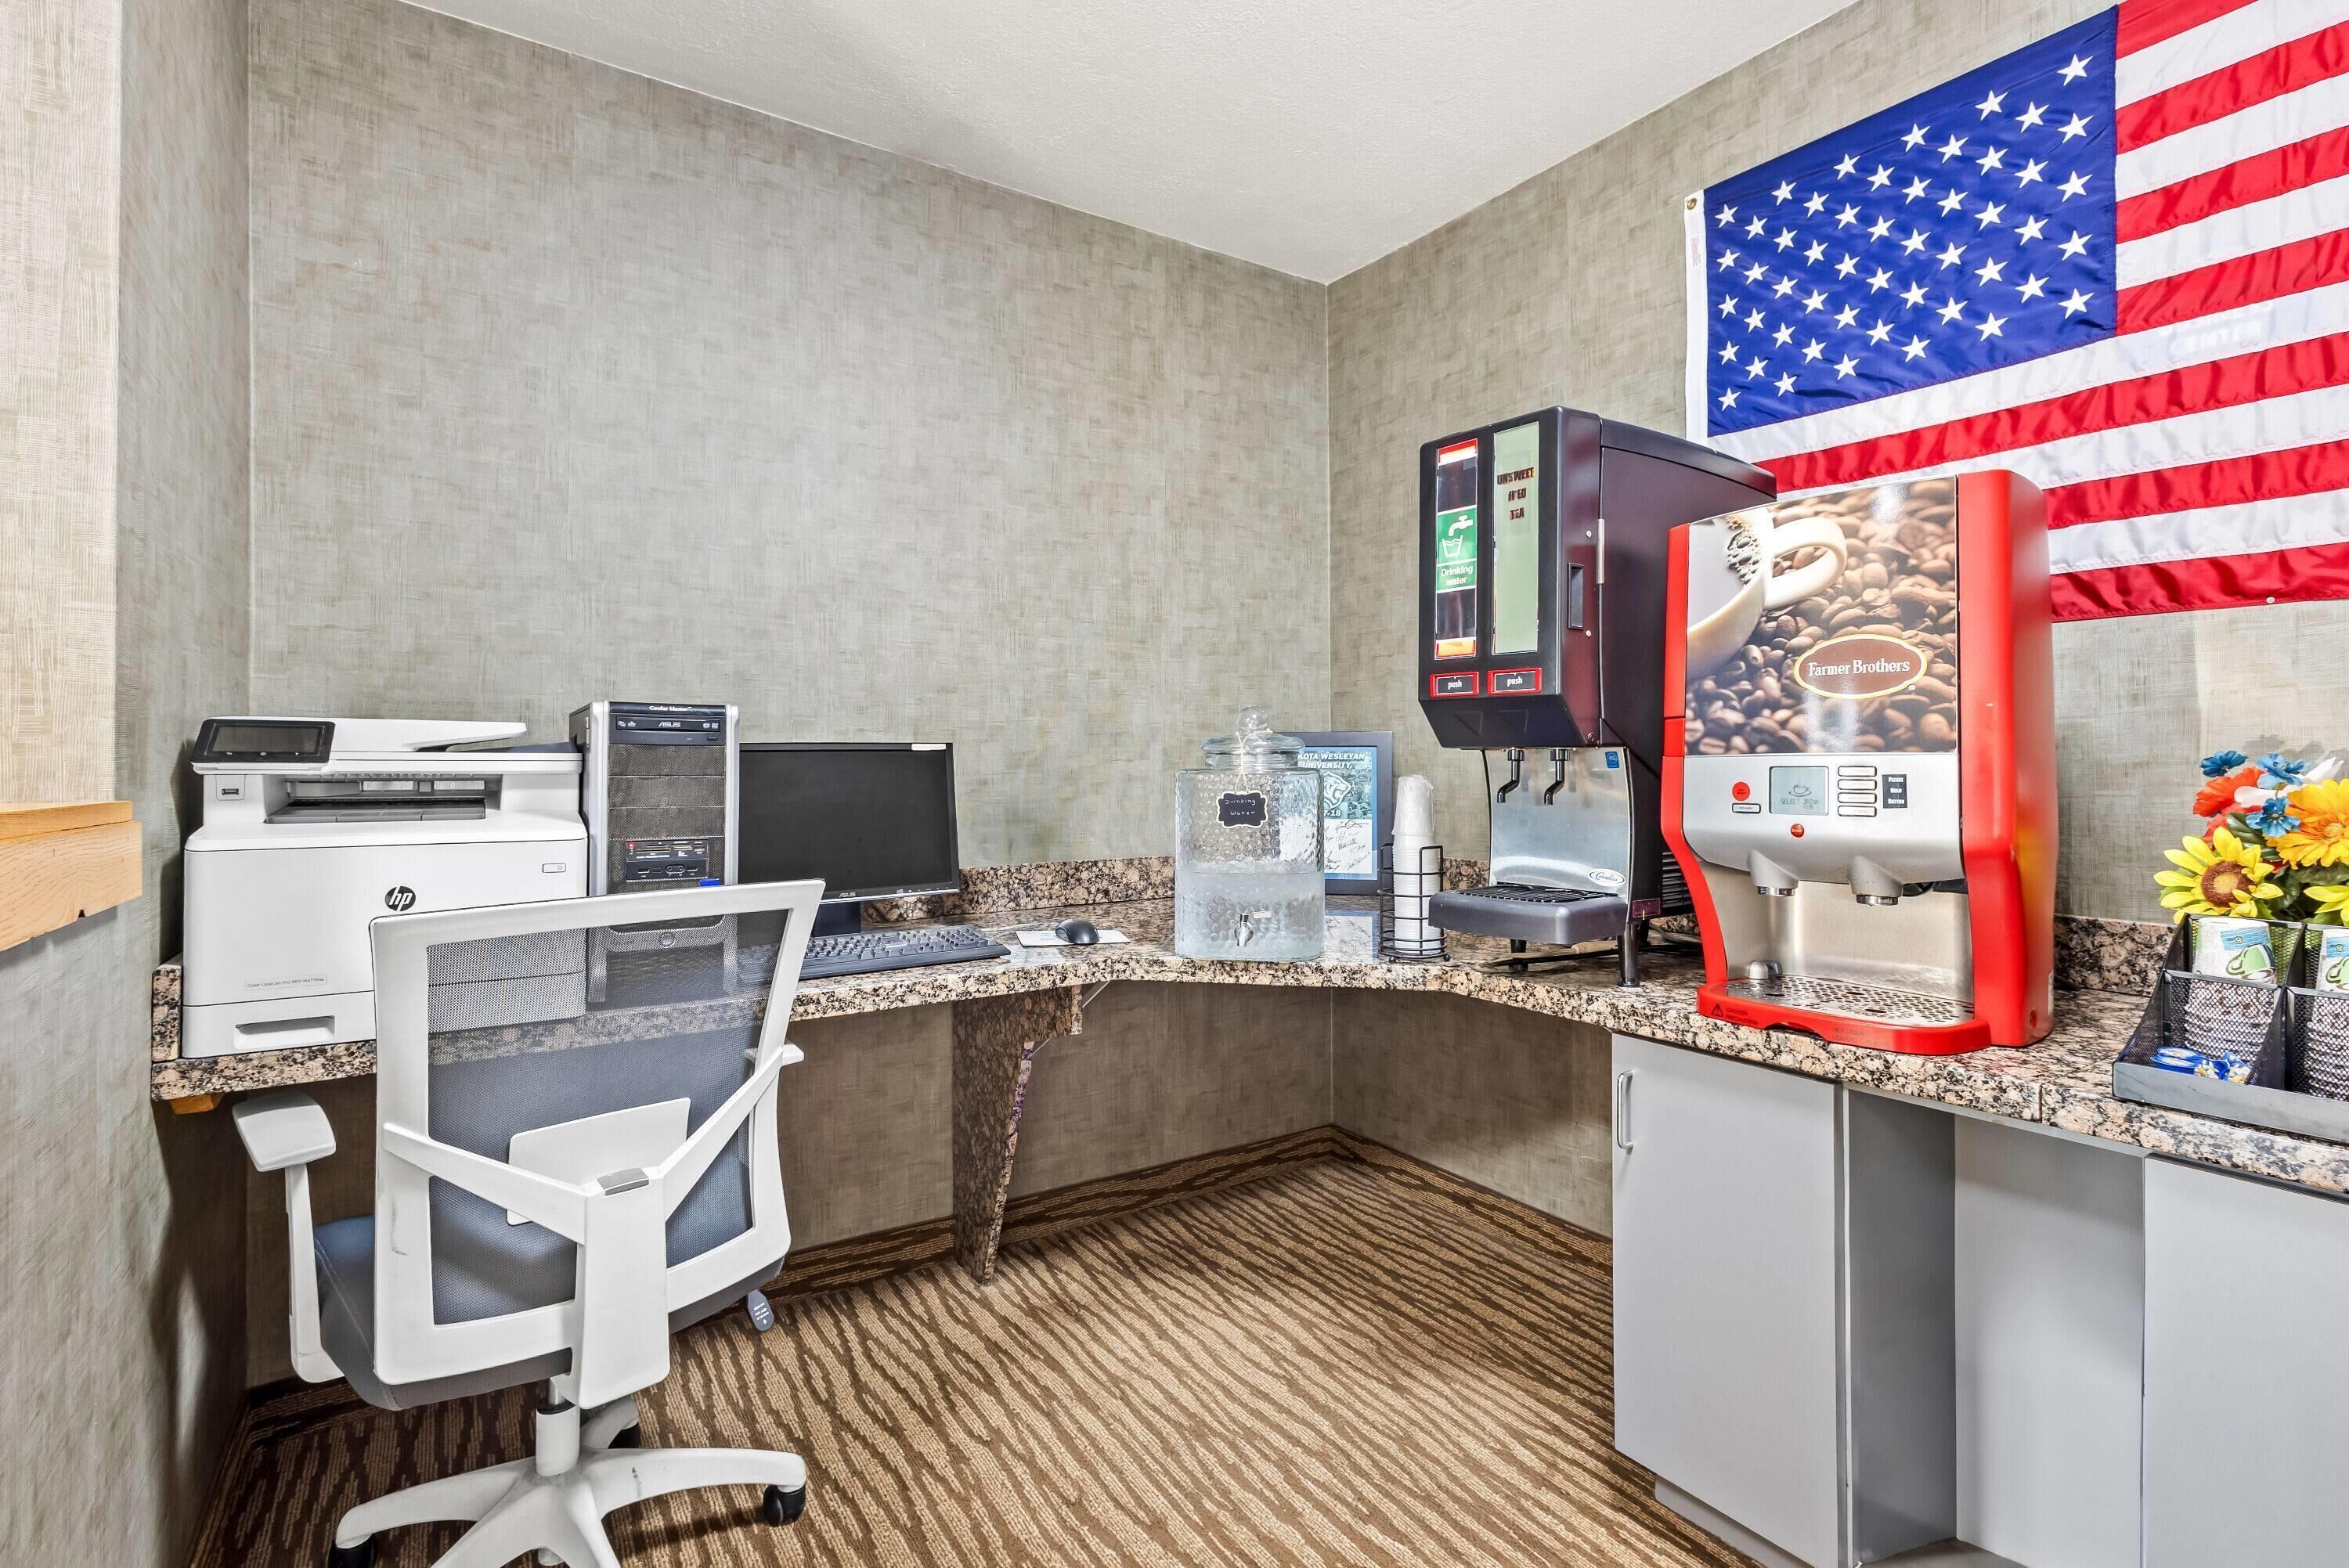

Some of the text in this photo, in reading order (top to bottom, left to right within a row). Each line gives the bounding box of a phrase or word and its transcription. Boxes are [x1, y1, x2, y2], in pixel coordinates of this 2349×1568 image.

[1496, 467, 1535, 485] UNSWEET
[1510, 506, 1525, 521] TEA
[1441, 565, 1474, 577] Drinking
[1445, 576, 1467, 586] water
[1808, 658, 1911, 677] Farmer Brothers
[1448, 679, 1463, 690] push
[1506, 676, 1523, 687] push
[1297, 752, 1366, 761] KOTA WESLEYAN
[1302, 761, 1353, 770] UNIVERSITY,
[388, 886, 413, 911] hp
